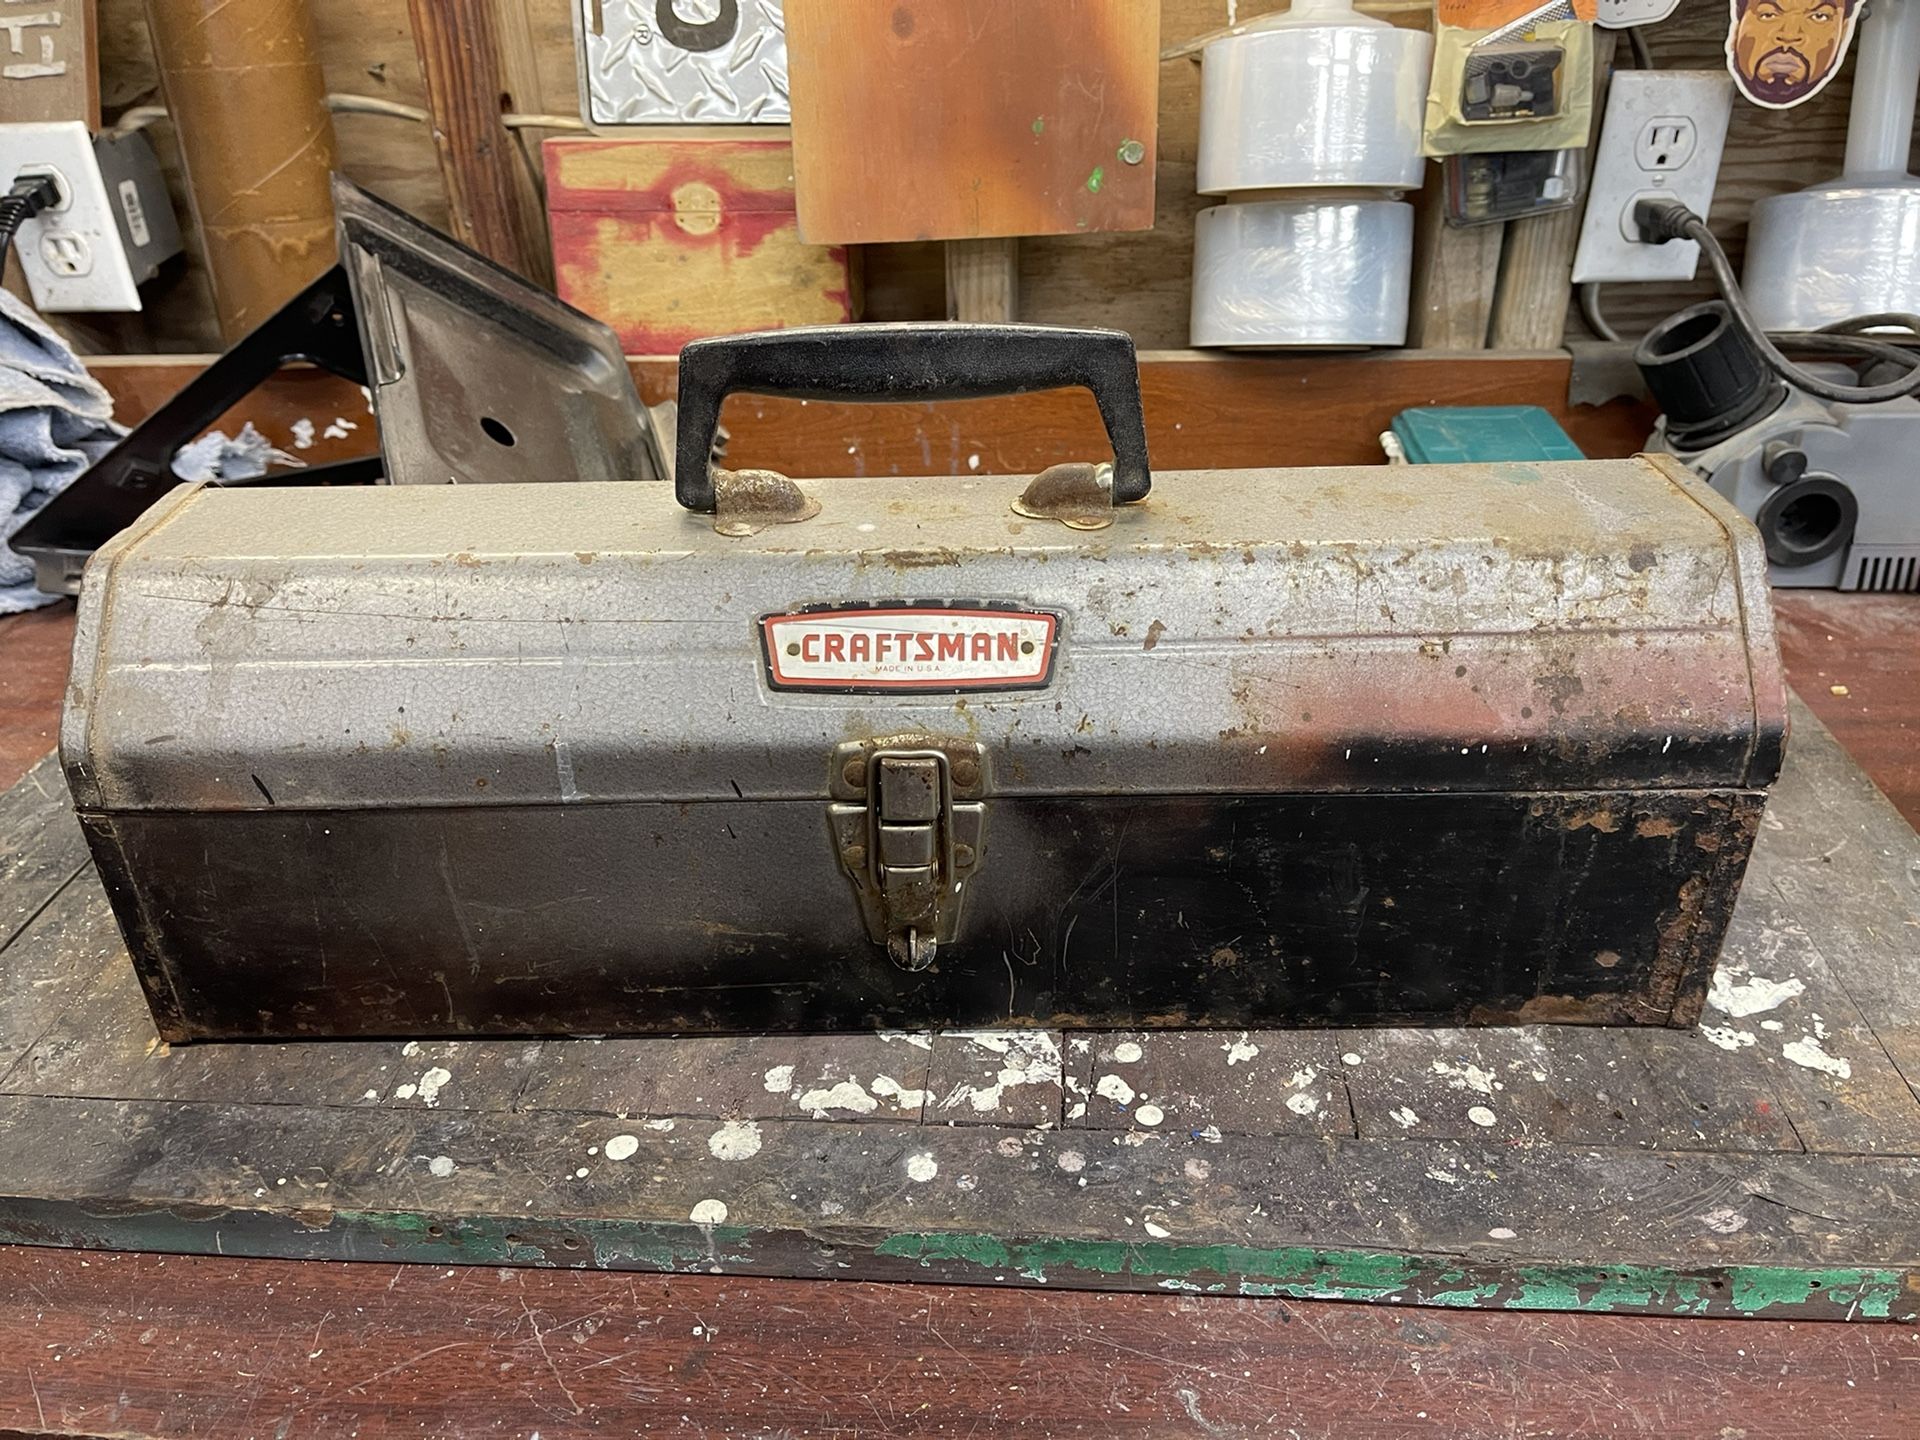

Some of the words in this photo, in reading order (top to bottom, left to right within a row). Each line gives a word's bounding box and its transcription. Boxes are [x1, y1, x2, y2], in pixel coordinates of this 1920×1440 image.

[802, 632, 1019, 662] CRAFTSMAN
[875, 664, 901, 672] MADE
[903, 664, 913, 672] IN
